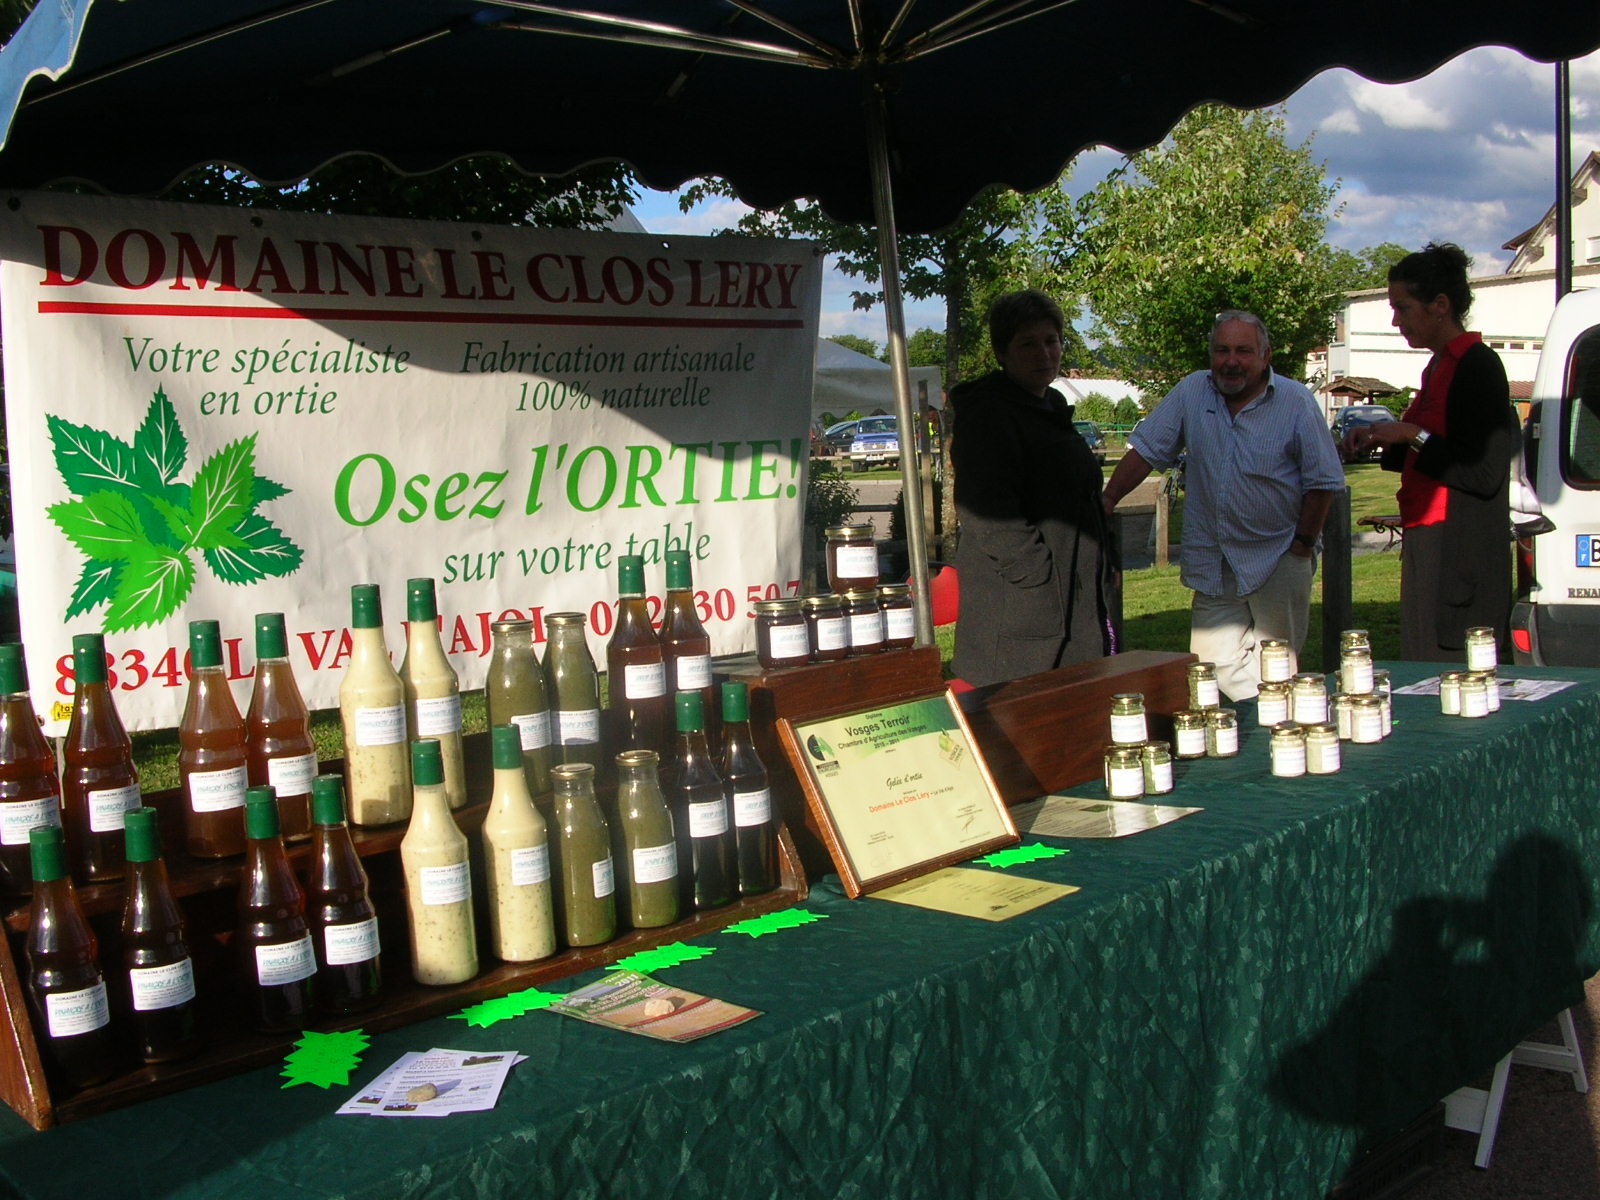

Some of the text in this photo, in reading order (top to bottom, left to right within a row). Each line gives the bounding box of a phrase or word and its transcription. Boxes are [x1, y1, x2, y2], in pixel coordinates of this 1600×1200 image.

[37, 225, 803, 309] DOMAINE LE CLOS LERY
[122, 336, 411, 385] Votre spécialiste
[460, 340, 756, 375] Fabrication artisanale
[199, 381, 338, 416] en ortie
[515, 376, 711, 412] 100% naturelle
[334, 438, 802, 527] Osez l'ORTIE!
[442, 521, 711, 585] sur votre table
[1567, 587, 1600, 599] RENA
[55, 647, 192, 696] 834
[296, 627, 393, 671] VA
[692, 587, 736, 624] 30
[837, 738, 864, 750] Chambre
[863, 730, 898, 744] d'Agriculture
[844, 714, 911, 737] Vosges Terroir
[886, 771, 924, 790] Gelée d'ortie
[868, 800, 895, 814] Domaine
[895, 798, 903, 806] Le
[903, 794, 917, 804] Clos
[917, 790, 931, 800] Léry
[615, 974, 640, 987] 2011
